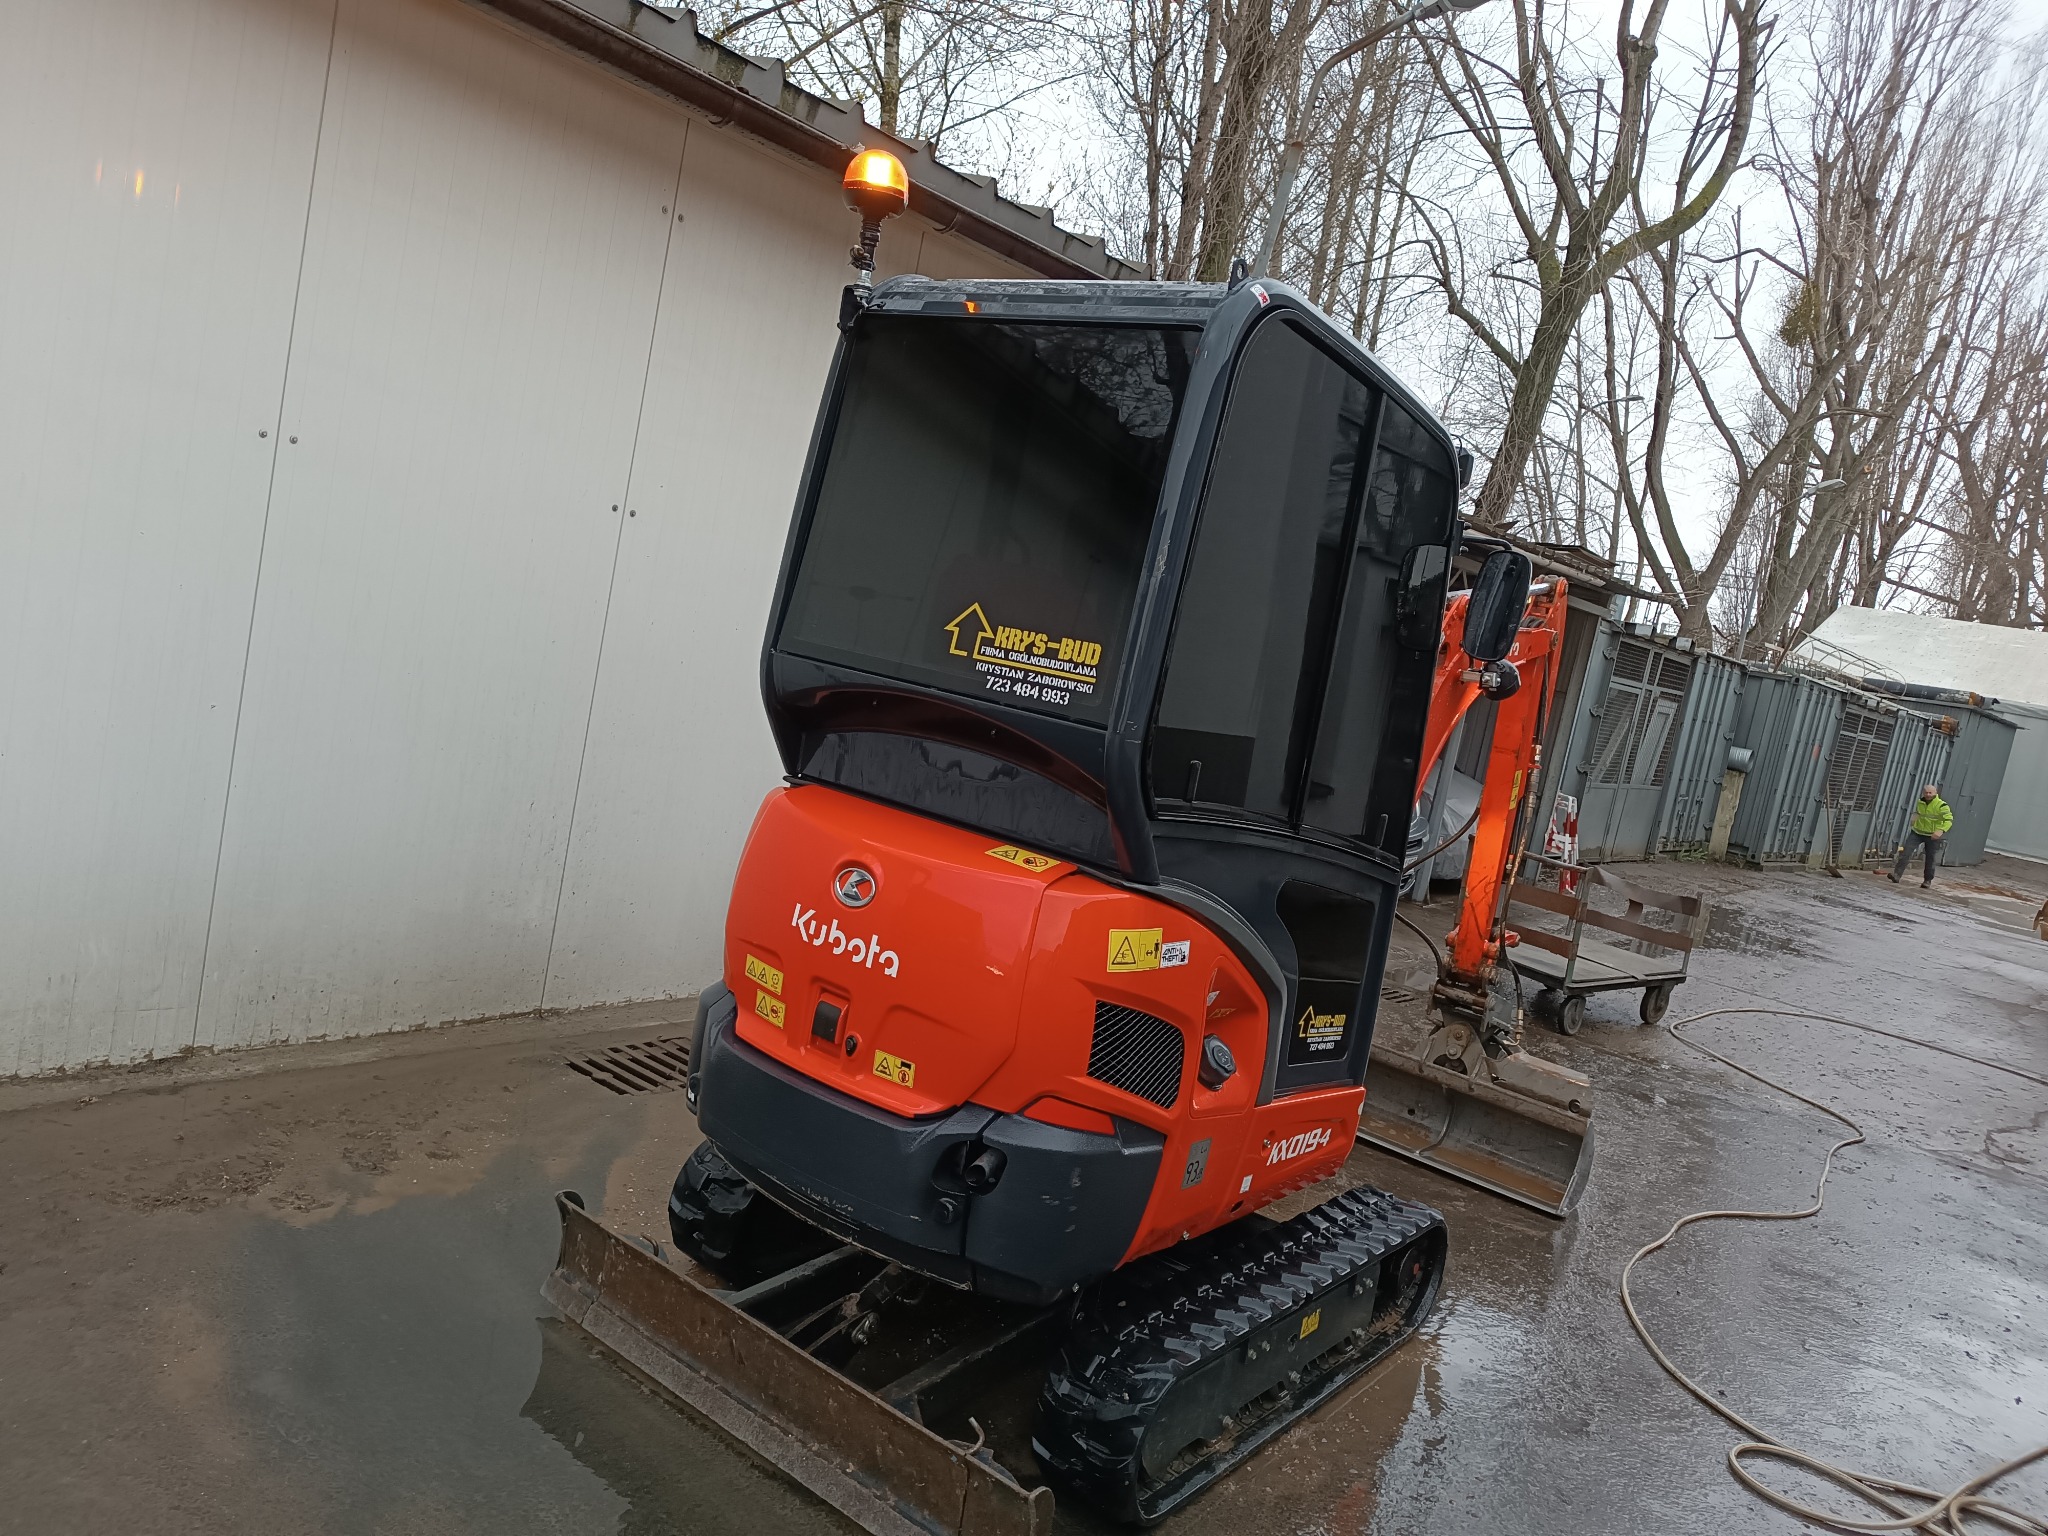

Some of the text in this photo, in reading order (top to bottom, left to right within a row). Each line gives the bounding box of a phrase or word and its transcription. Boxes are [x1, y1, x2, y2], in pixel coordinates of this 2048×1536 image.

[980, 645, 1005, 659] FIRMA
[994, 625, 1102, 666] KRYS-BUD
[975, 661, 1094, 694] KRYSTIAN ZABOROWSKI
[985, 675, 1070, 705] 723 484 993
[791, 902, 899, 978] Kubota
